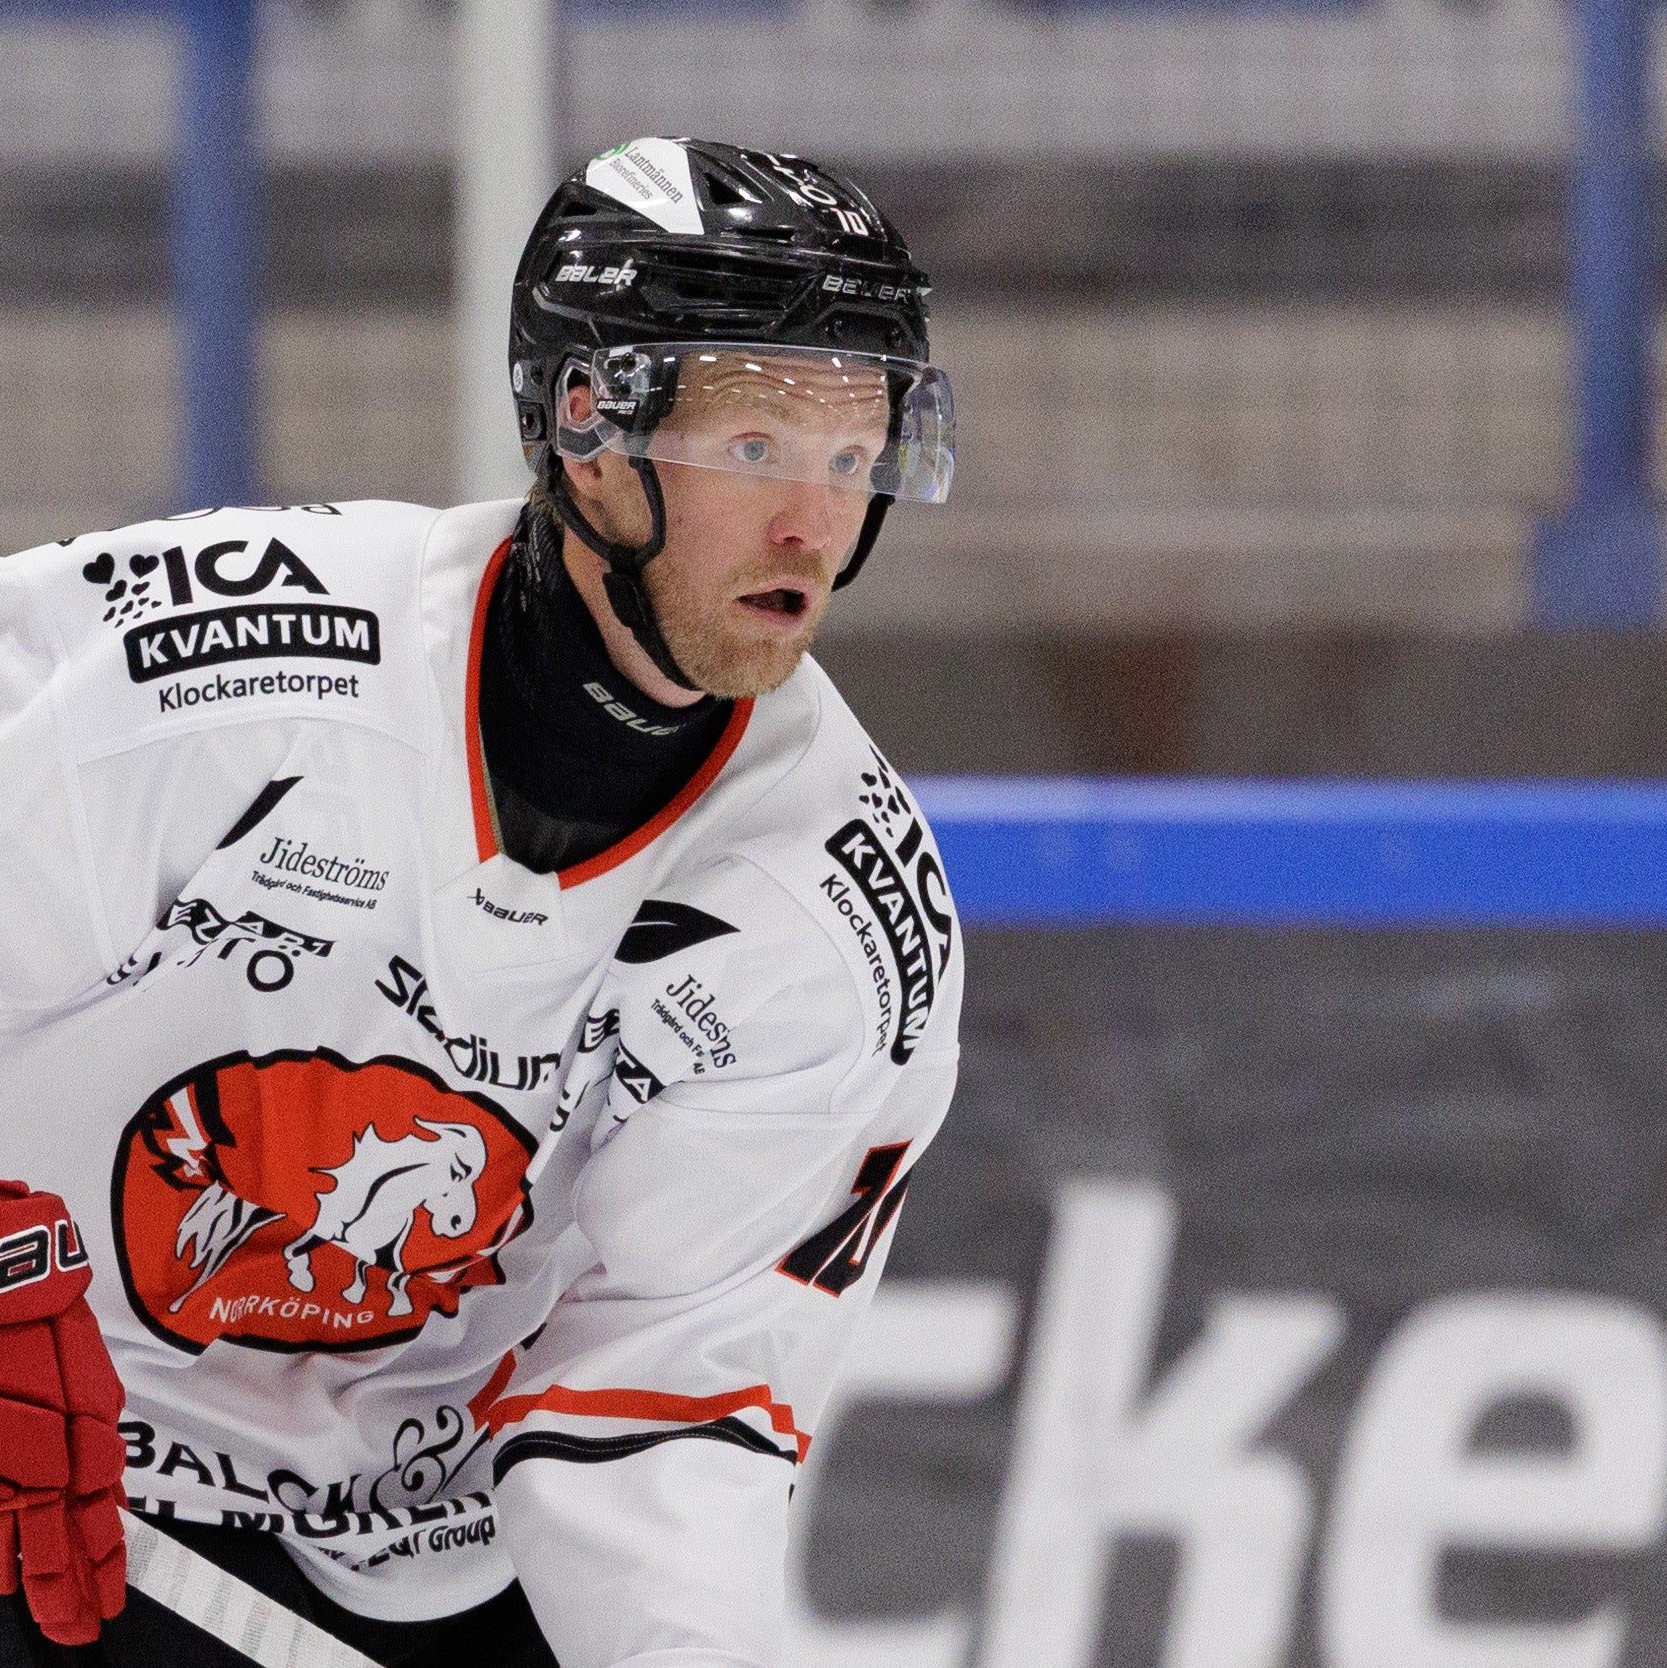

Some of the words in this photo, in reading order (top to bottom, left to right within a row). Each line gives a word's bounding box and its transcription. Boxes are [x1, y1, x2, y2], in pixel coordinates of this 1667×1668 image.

[624, 145, 684, 204] Lantmännen
[162, 537, 331, 607] ICA
[138, 612, 371, 670] KVANTUM
[158, 670, 360, 713] Klockaretorpet
[259, 835, 390, 892] Jideströms
[285, 880, 302, 893] och
[364, 898, 378, 910] AB
[481, 900, 549, 926] BAUER
[840, 831, 931, 1051] KVANTUM
[679, 1031, 694, 1048] och
[208, 1294, 375, 1329] NORRKÖPING
[428, 1513, 497, 1553] Group
